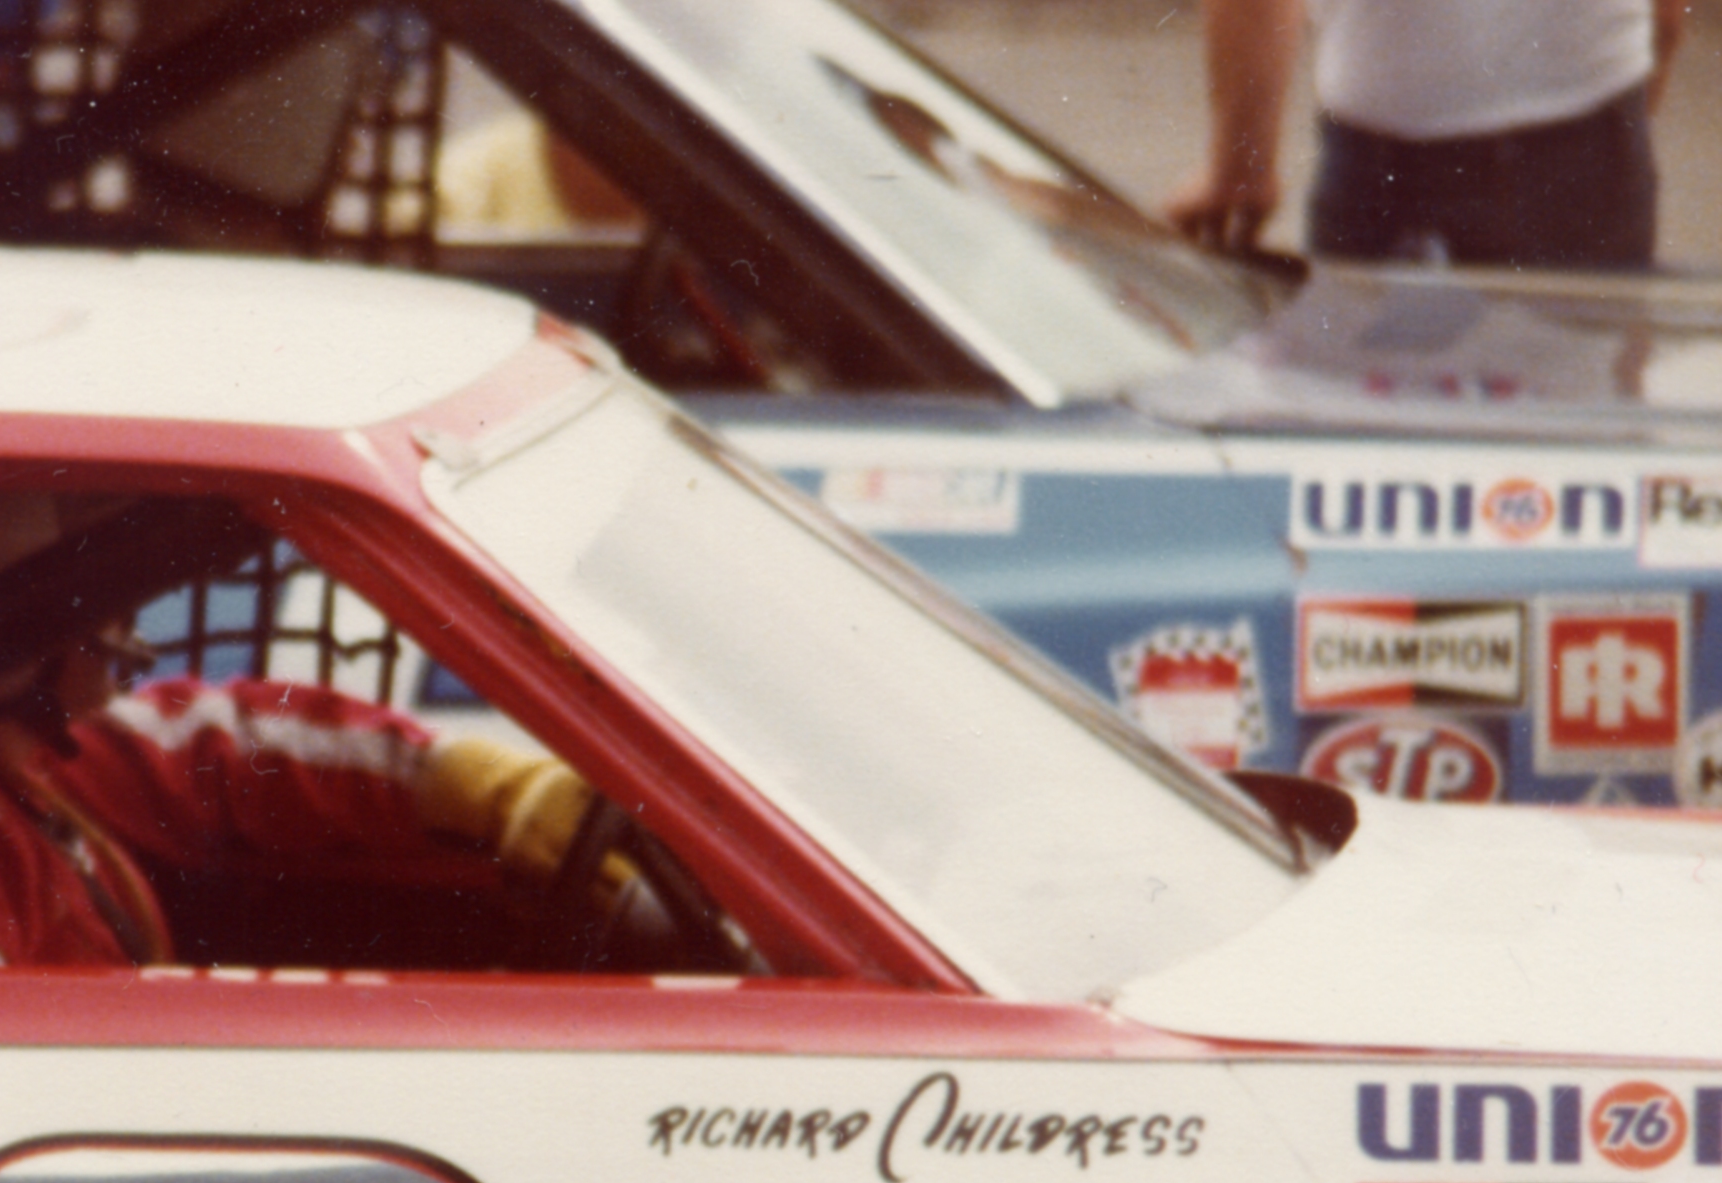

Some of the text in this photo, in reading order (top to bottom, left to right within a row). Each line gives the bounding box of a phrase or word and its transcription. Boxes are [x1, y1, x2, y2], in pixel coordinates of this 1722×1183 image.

[1314, 636, 1511, 671] CHAMPION
[647, 1106, 872, 1159] RICHARD
[1601, 1098, 1673, 1150] 76
